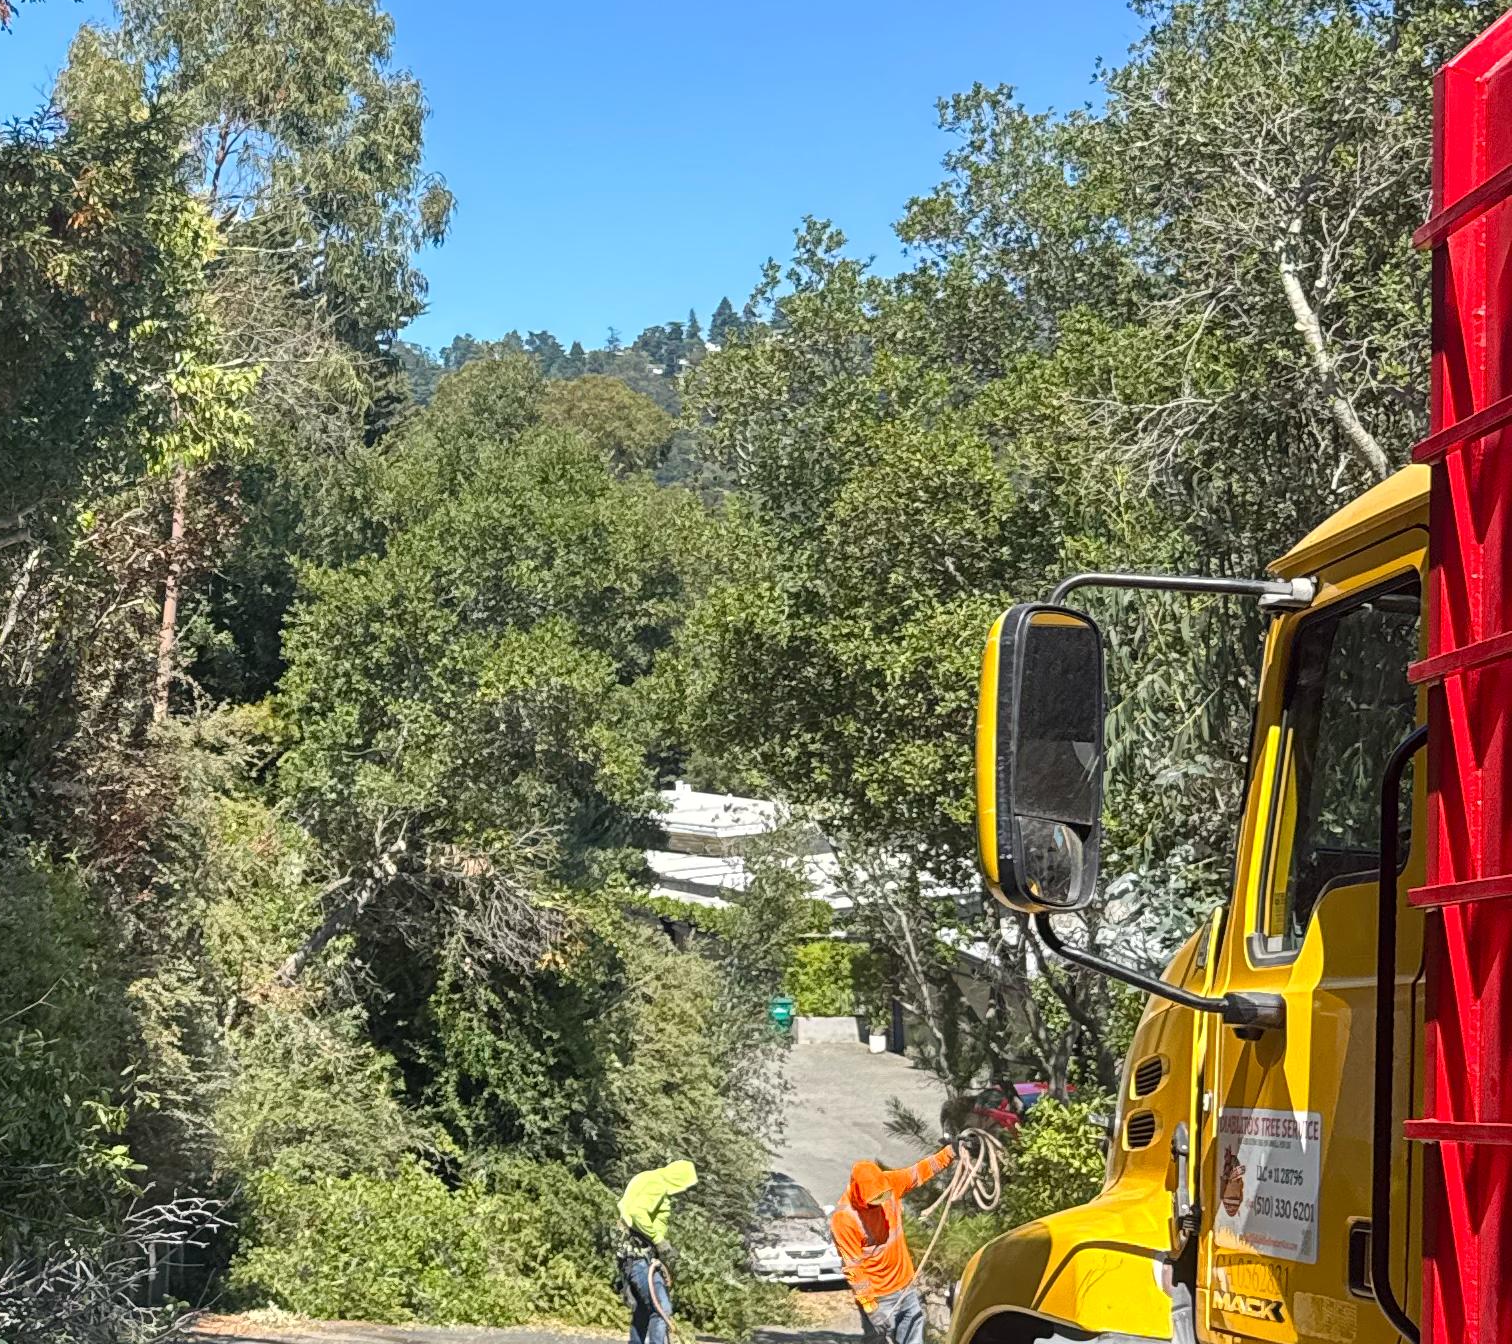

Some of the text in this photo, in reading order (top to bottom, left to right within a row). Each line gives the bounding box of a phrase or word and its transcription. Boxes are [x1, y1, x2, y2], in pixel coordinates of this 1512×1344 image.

[1261, 1117, 1281, 1138] TREE
[1254, 1195, 1315, 1223] (510) 330 6201
[1212, 1290, 1285, 1322] MACK
